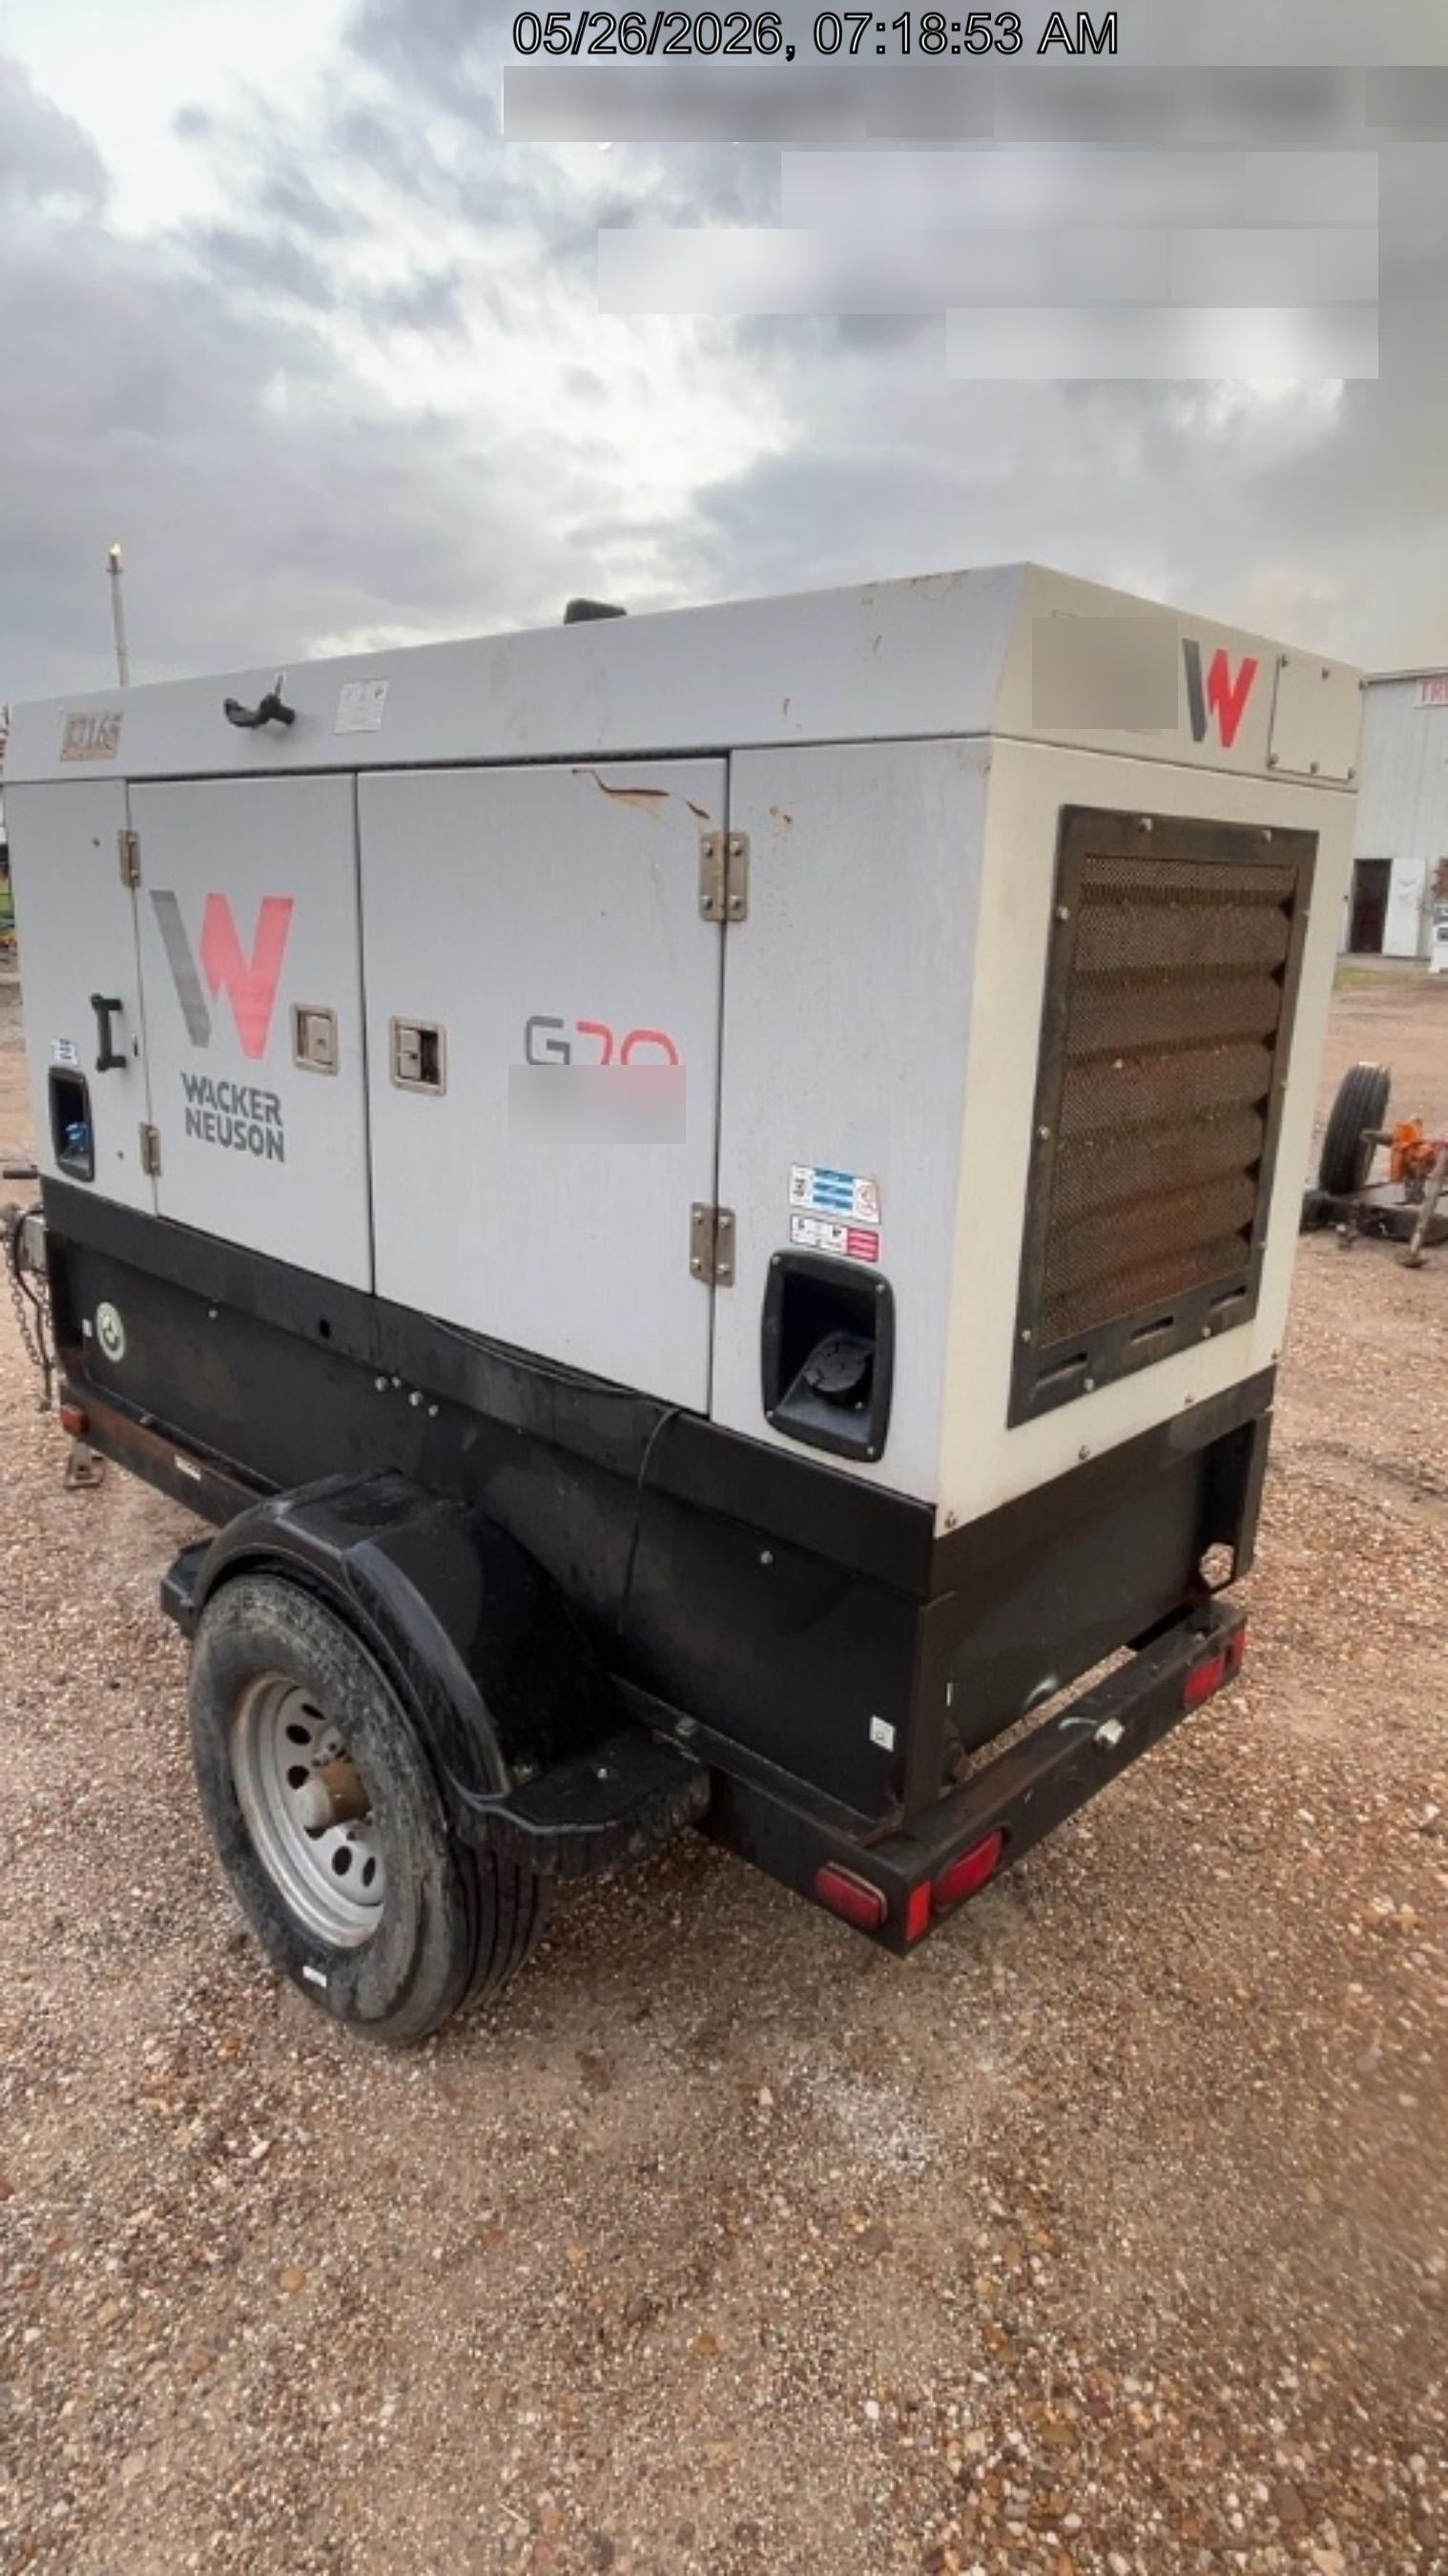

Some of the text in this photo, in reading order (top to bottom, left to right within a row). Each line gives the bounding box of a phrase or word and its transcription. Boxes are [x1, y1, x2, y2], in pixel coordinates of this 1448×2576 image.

[1418, 677, 1448, 703] TR
[181, 1071, 284, 1127] WACKER
[185, 1107, 285, 1163] NEUSON
